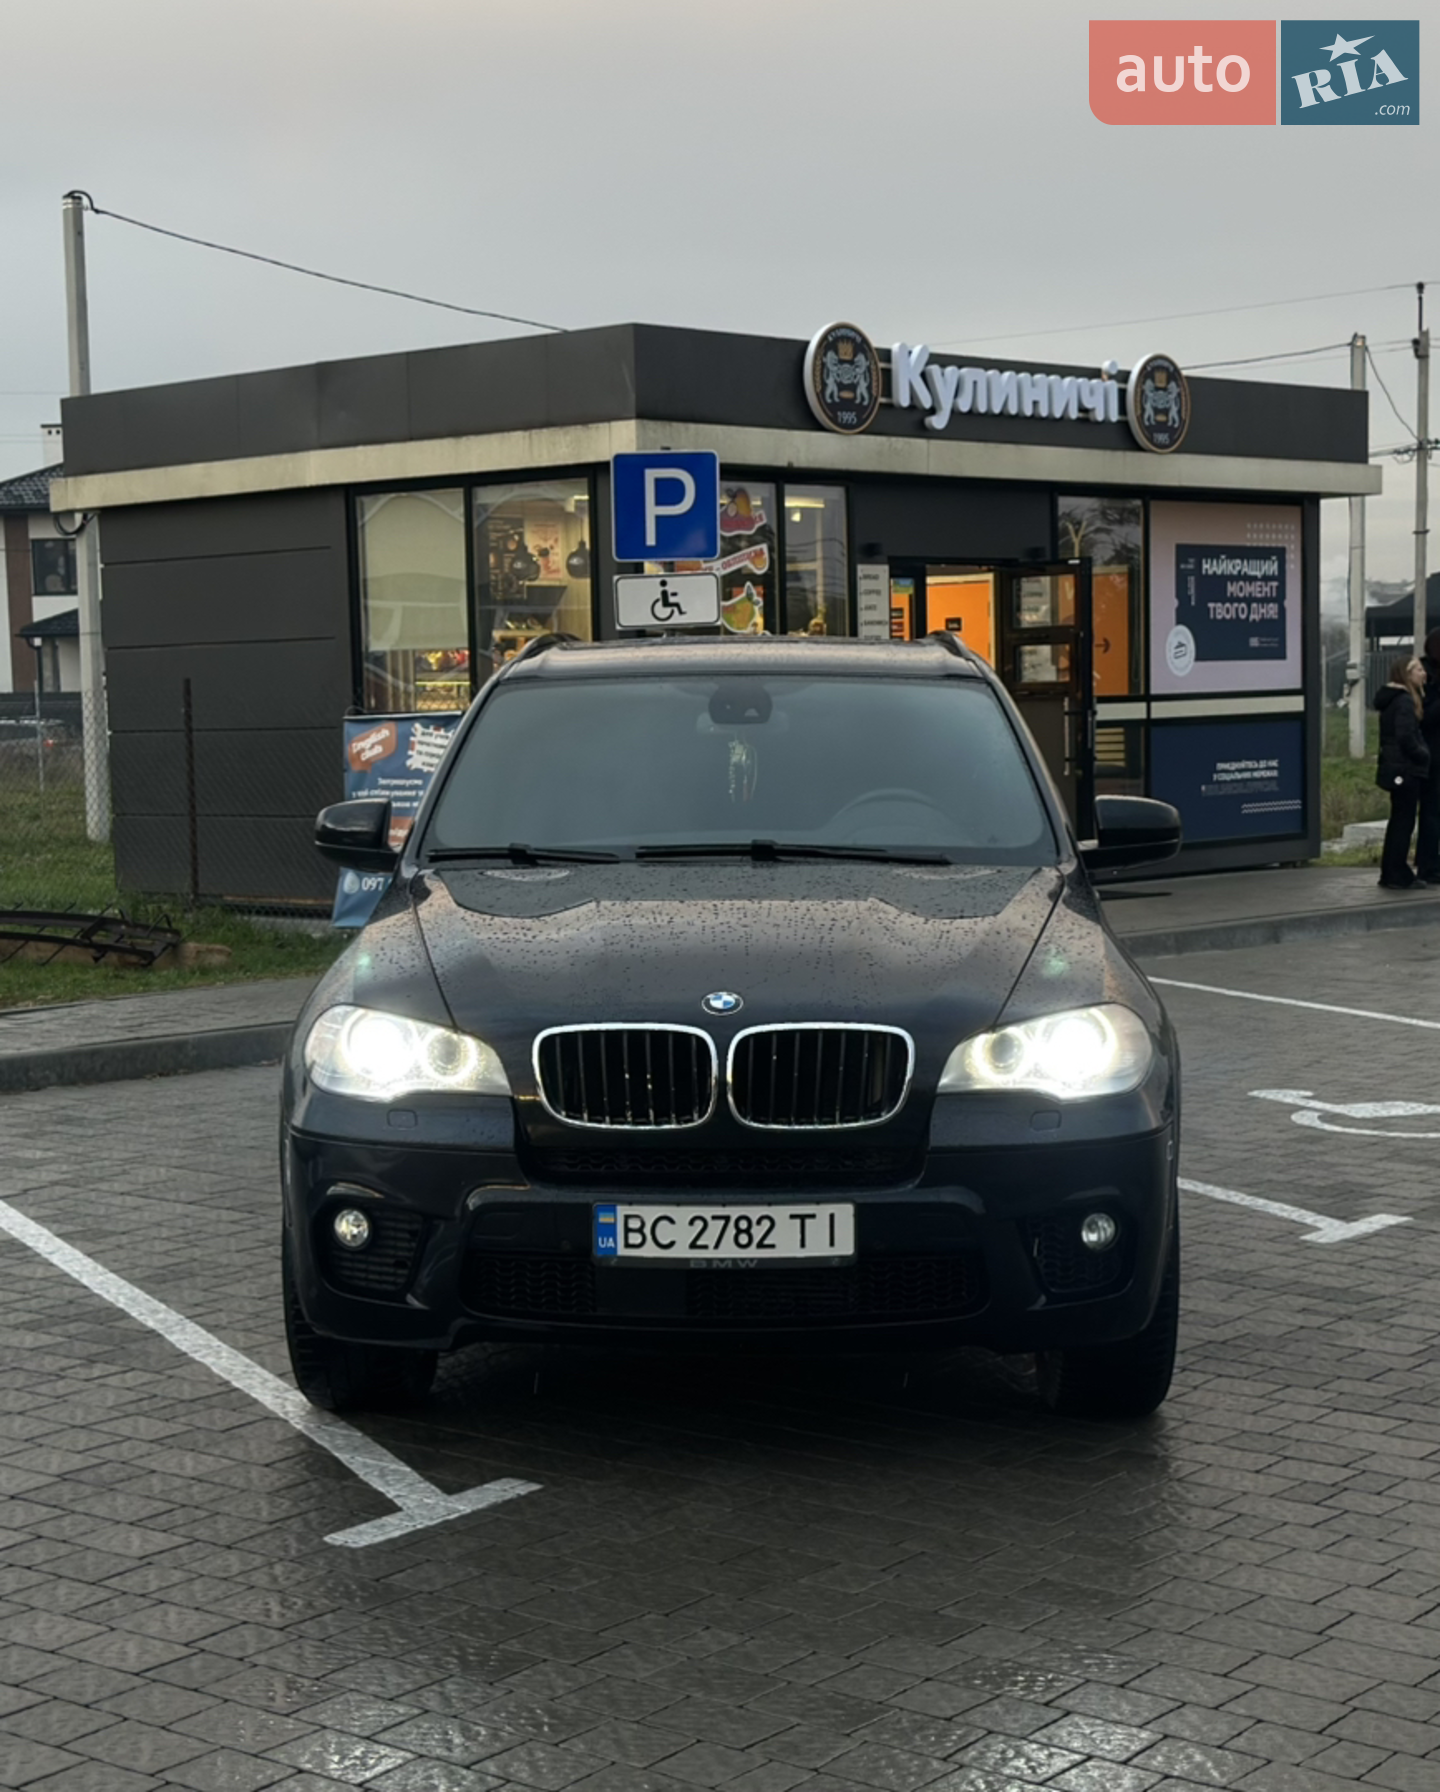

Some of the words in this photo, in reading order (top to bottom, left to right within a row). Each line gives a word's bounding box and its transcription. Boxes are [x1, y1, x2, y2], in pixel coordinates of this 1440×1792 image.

[891, 341, 1119, 431] Кулиничі
[837, 411, 857, 425] 1995
[644, 468, 696, 547] P
[1202, 554, 1279, 578] НАЙКРАЩИЙ
[1227, 581, 1279, 598] МОМЕНТ
[1208, 602, 1248, 620] ТВОГО
[1249, 602, 1279, 622] ДНЯ!
[361, 876, 383, 892] 097
[623, 1214, 677, 1250] BC
[688, 1214, 776, 1250] 2782
[789, 1213, 836, 1249] TI
[598, 1237, 616, 1248] UA
[690, 1259, 759, 1268] BMW
